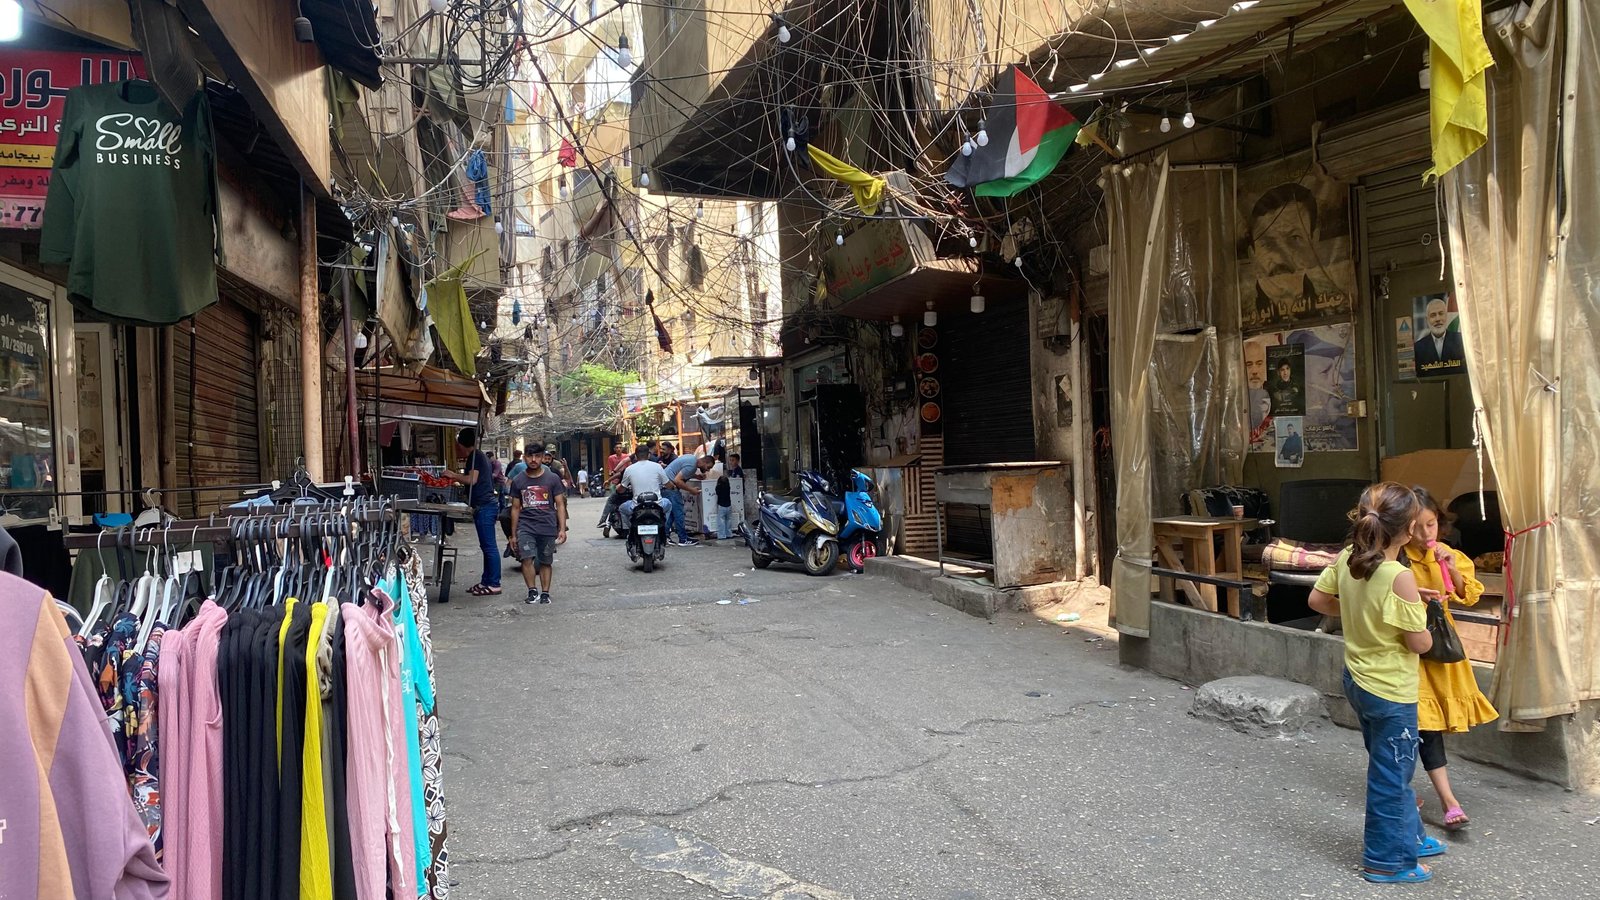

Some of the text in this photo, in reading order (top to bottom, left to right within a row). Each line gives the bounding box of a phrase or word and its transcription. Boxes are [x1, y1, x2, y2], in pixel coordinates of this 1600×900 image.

[95, 113, 182, 155] Small
[96, 153, 181, 170] BUSINESS
[0, 175, 33, 190] ومفر
[1278, 300, 1288, 320] يا
[1290, 295, 1312, 313] الله
[0, 313, 15, 328] داو
[1421, 360, 1460, 371] القائد الشهيد
